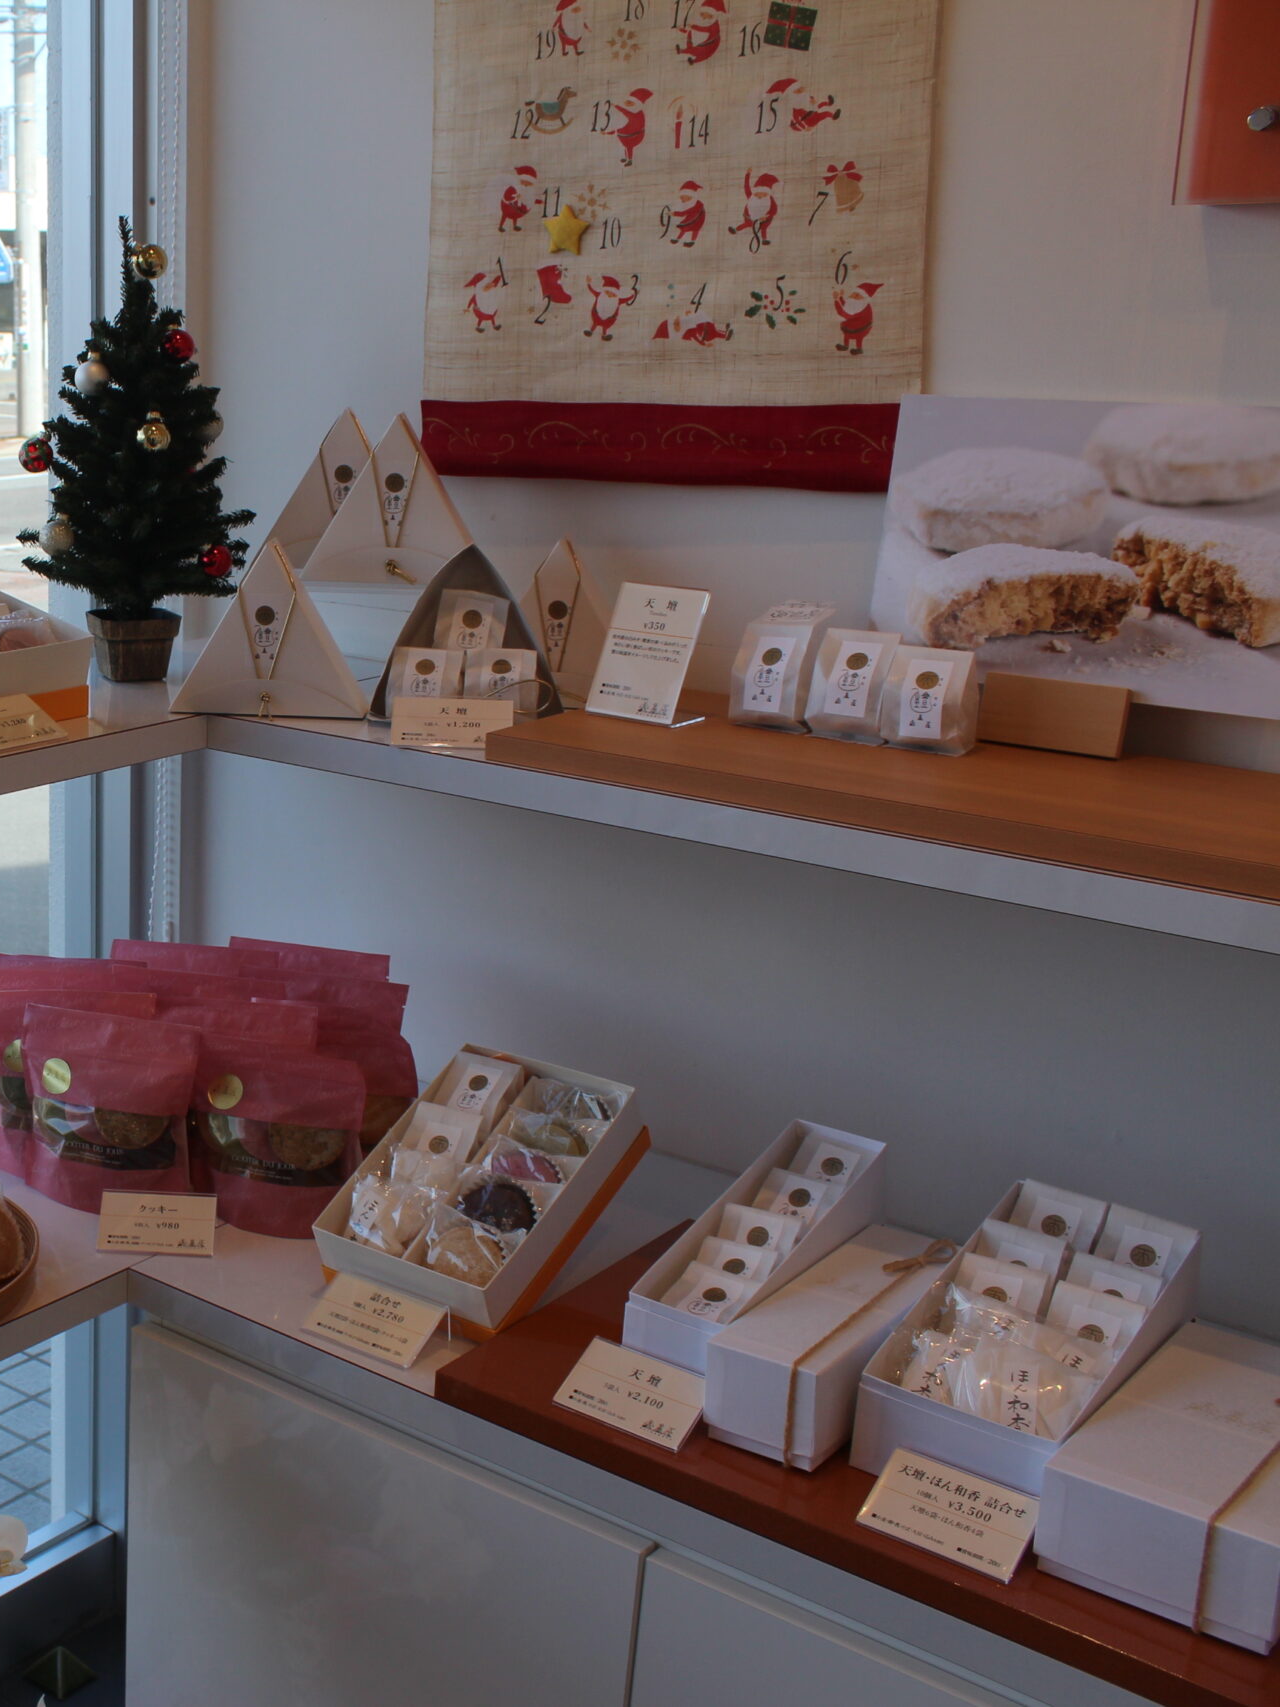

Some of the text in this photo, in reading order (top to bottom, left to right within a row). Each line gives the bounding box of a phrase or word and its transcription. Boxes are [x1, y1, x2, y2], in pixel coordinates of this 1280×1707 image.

[622, 0, 645, 21] 18
[671, 0, 694, 29] 17
[535, 29, 557, 60] 19
[737, 24, 762, 57] 16
[508, 109, 534, 139] 12
[590, 100, 612, 132] 13
[688, 113, 710, 148] 14
[753, 98, 779, 133] 15
[541, 186, 561, 218] 11
[806, 191, 829, 227] 7
[599, 217, 622, 249] 10
[659, 207, 672, 238] 9
[748, 220, 761, 254] 8
[495, 256, 509, 287] 1
[834, 252, 853, 285] 6
[626, 275, 640, 306] 3
[689, 282, 708, 313] 4
[773, 275, 787, 311] 5
[533, 295, 552, 325] 2
[643, 621, 666, 631] ¥350
[140, 1204, 179, 1214] クッキー
[156, 1222, 180, 1230] ¥980
[626, 1391, 664, 1410] ¥2,100
[898, 1463, 1027, 1519] 天壇・ほん和香 詰合せ
[947, 1500, 992, 1523] ¥3,500
